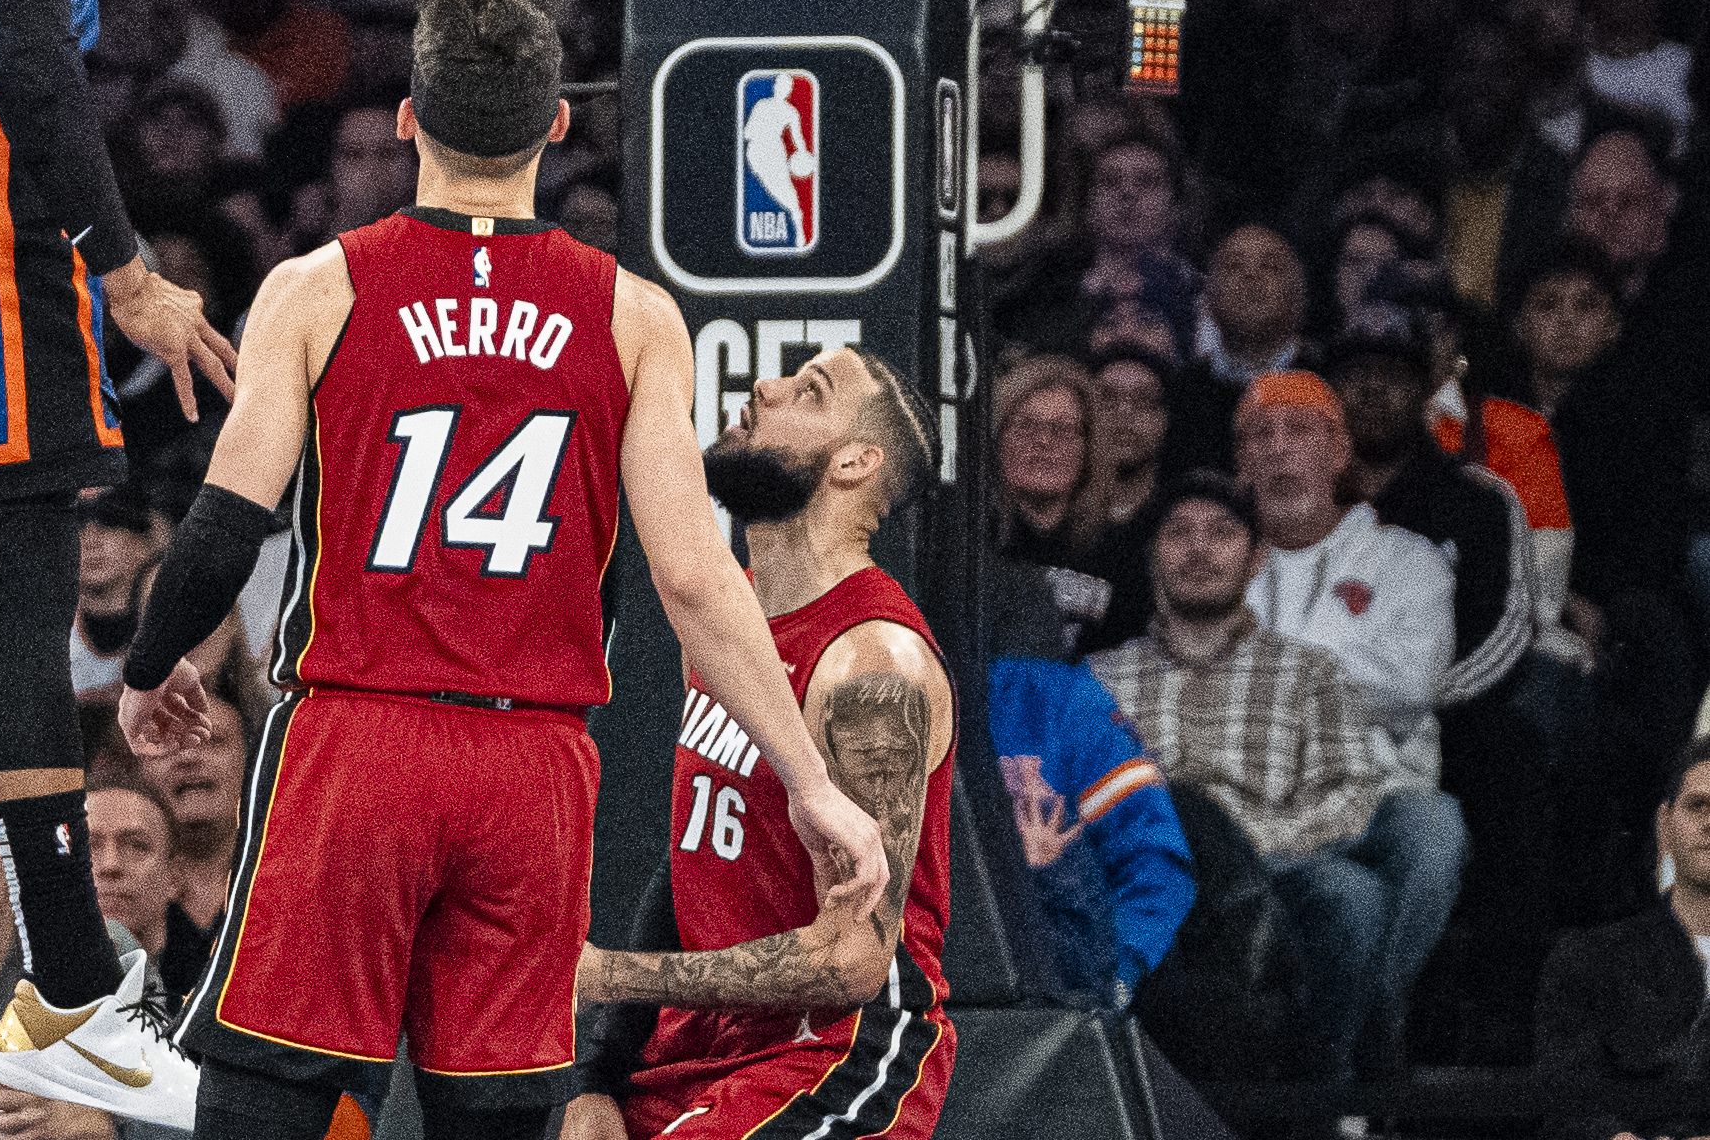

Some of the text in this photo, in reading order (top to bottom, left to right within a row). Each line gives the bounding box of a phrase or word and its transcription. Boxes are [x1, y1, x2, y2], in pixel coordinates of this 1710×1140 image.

[750, 211, 788, 241] NBA
[398, 297, 574, 371] HERRO
[366, 405, 577, 578] 14
[679, 774, 747, 861] 16
